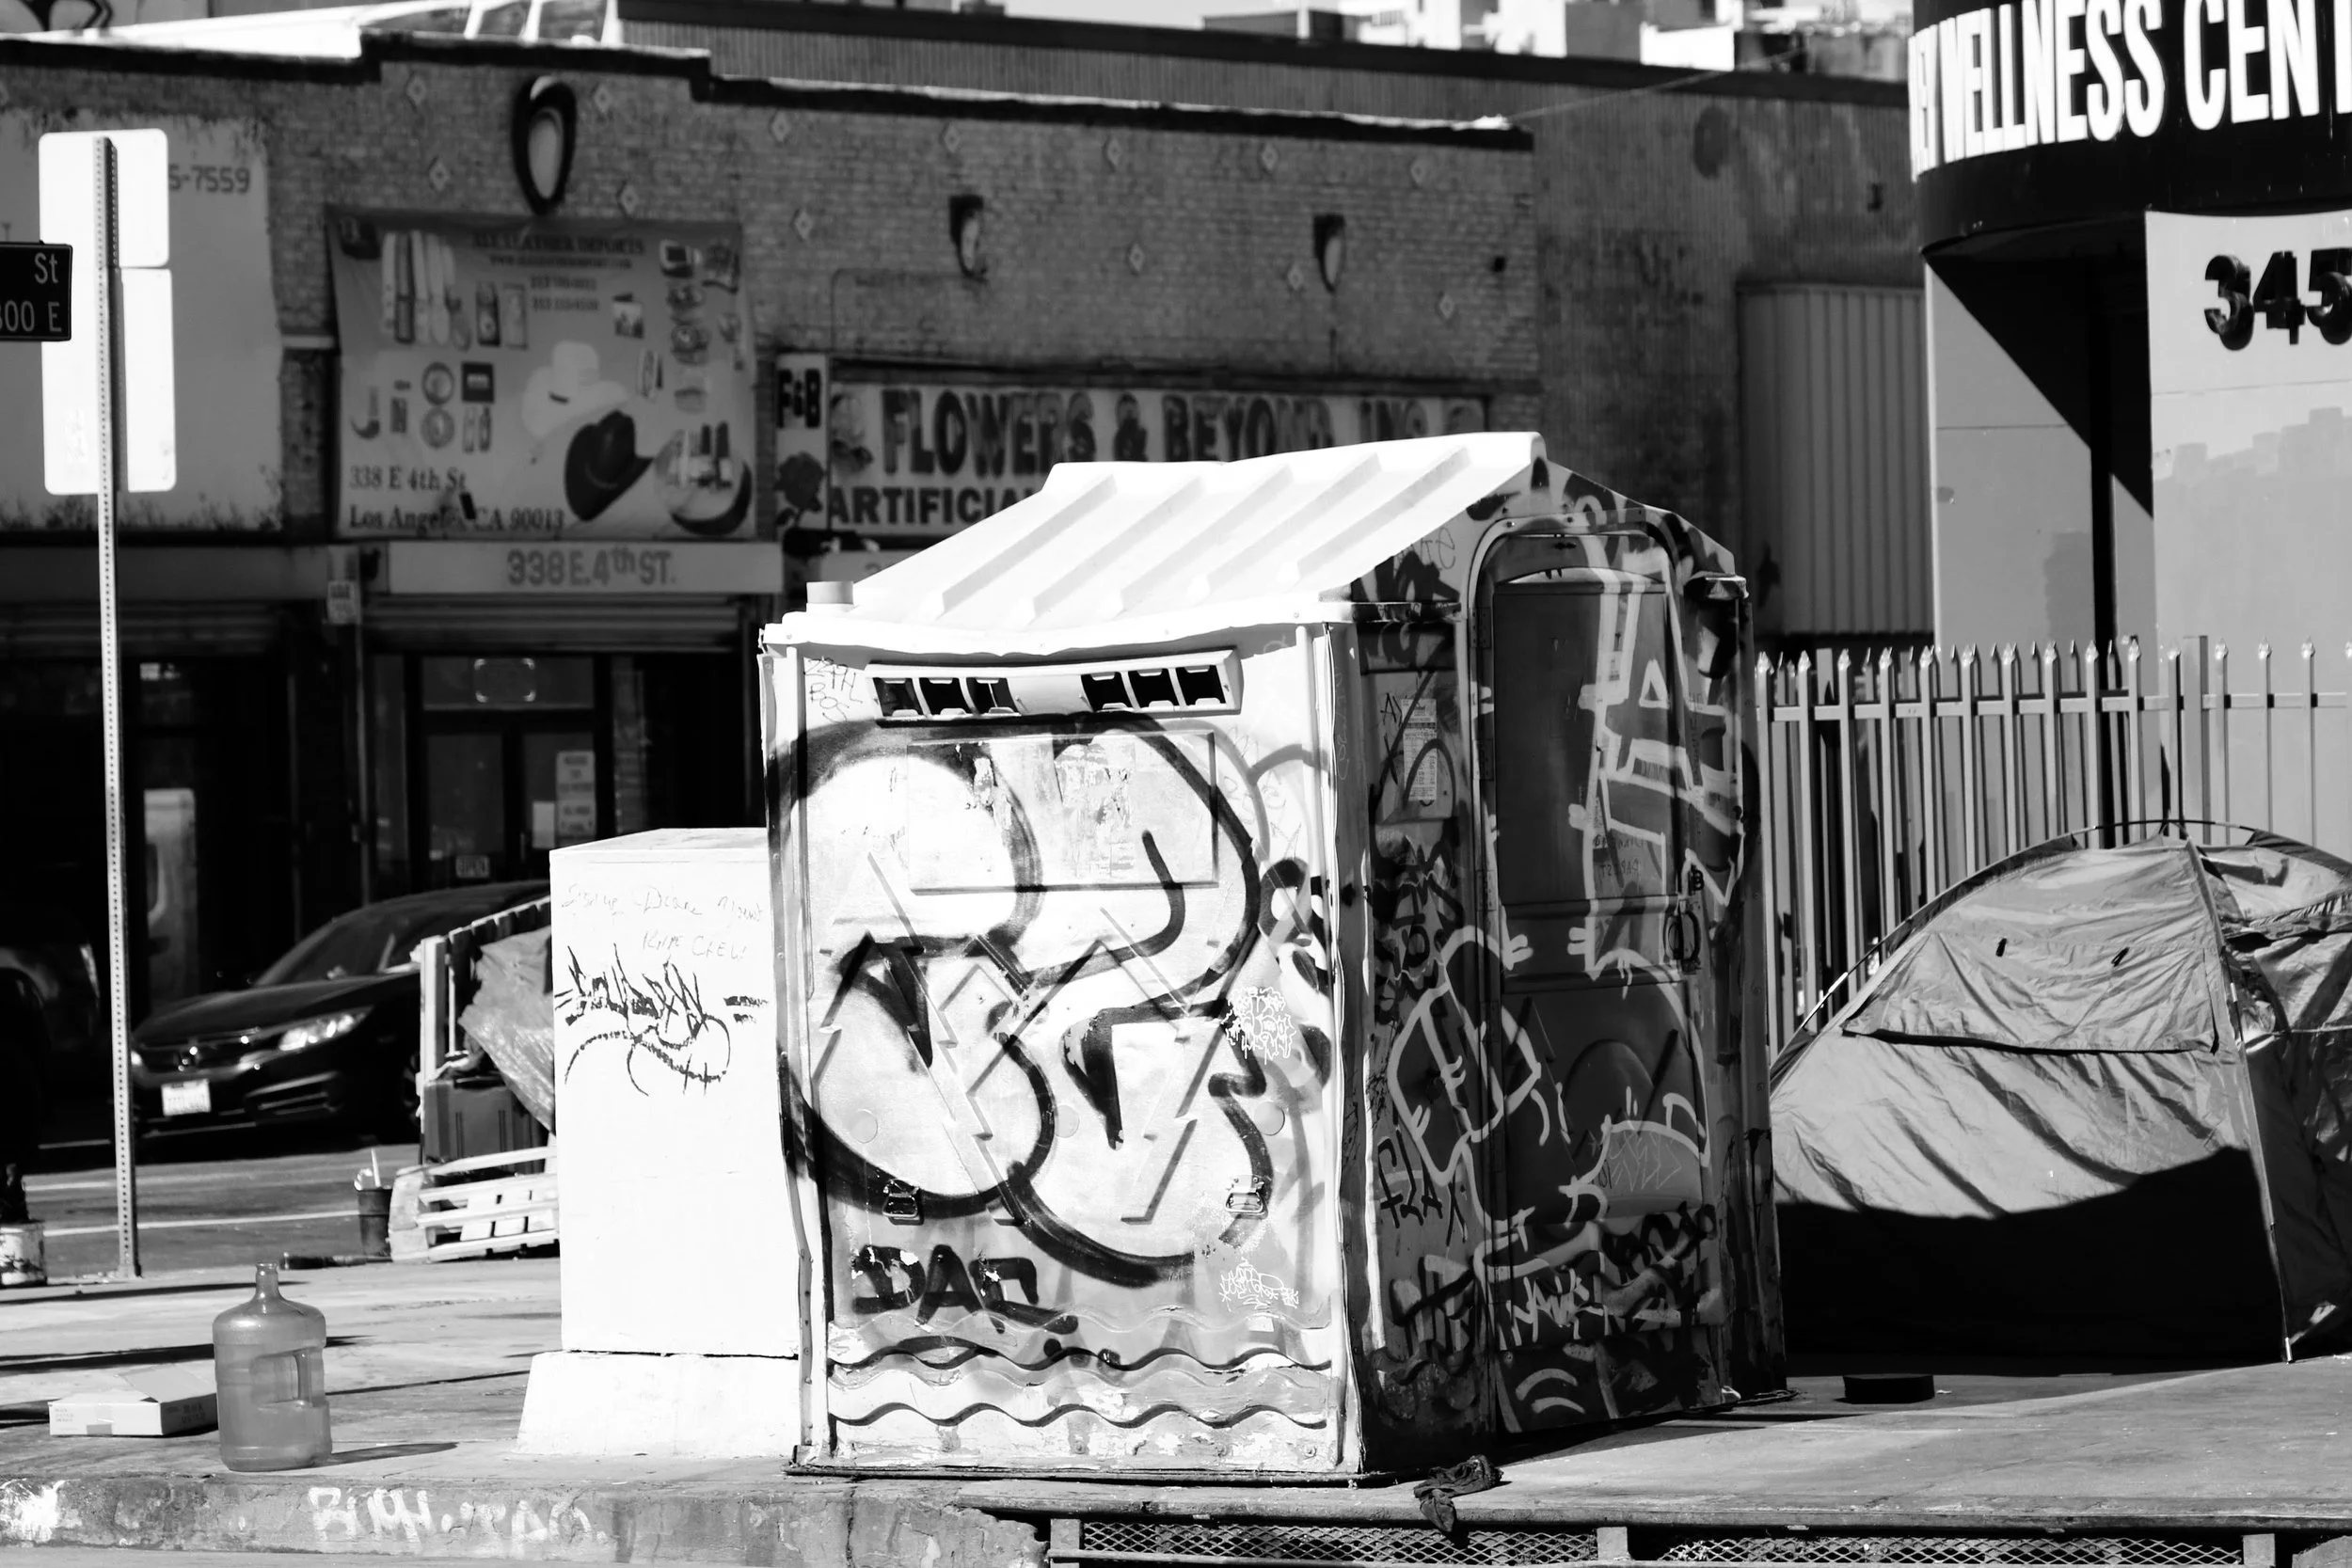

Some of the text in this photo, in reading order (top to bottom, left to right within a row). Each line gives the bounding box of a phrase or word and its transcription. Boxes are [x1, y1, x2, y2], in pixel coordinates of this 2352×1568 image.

[1939, 0, 2166, 164] WELLNESS
[34, 252, 58, 284] St
[0, 300, 62, 332] 00 E
[2204, 248, 2352, 351] 345
[881, 388, 1097, 477] FLOWERS
[1114, 392, 1148, 462] &
[1162, 392, 1335, 462] BEYOND
[389, 466, 404, 490] E
[407, 467, 440, 491] 4th
[829, 486, 1034, 526] ARTIFICIA
[507, 548, 564, 587] 338
[593, 544, 636, 587] 4th
